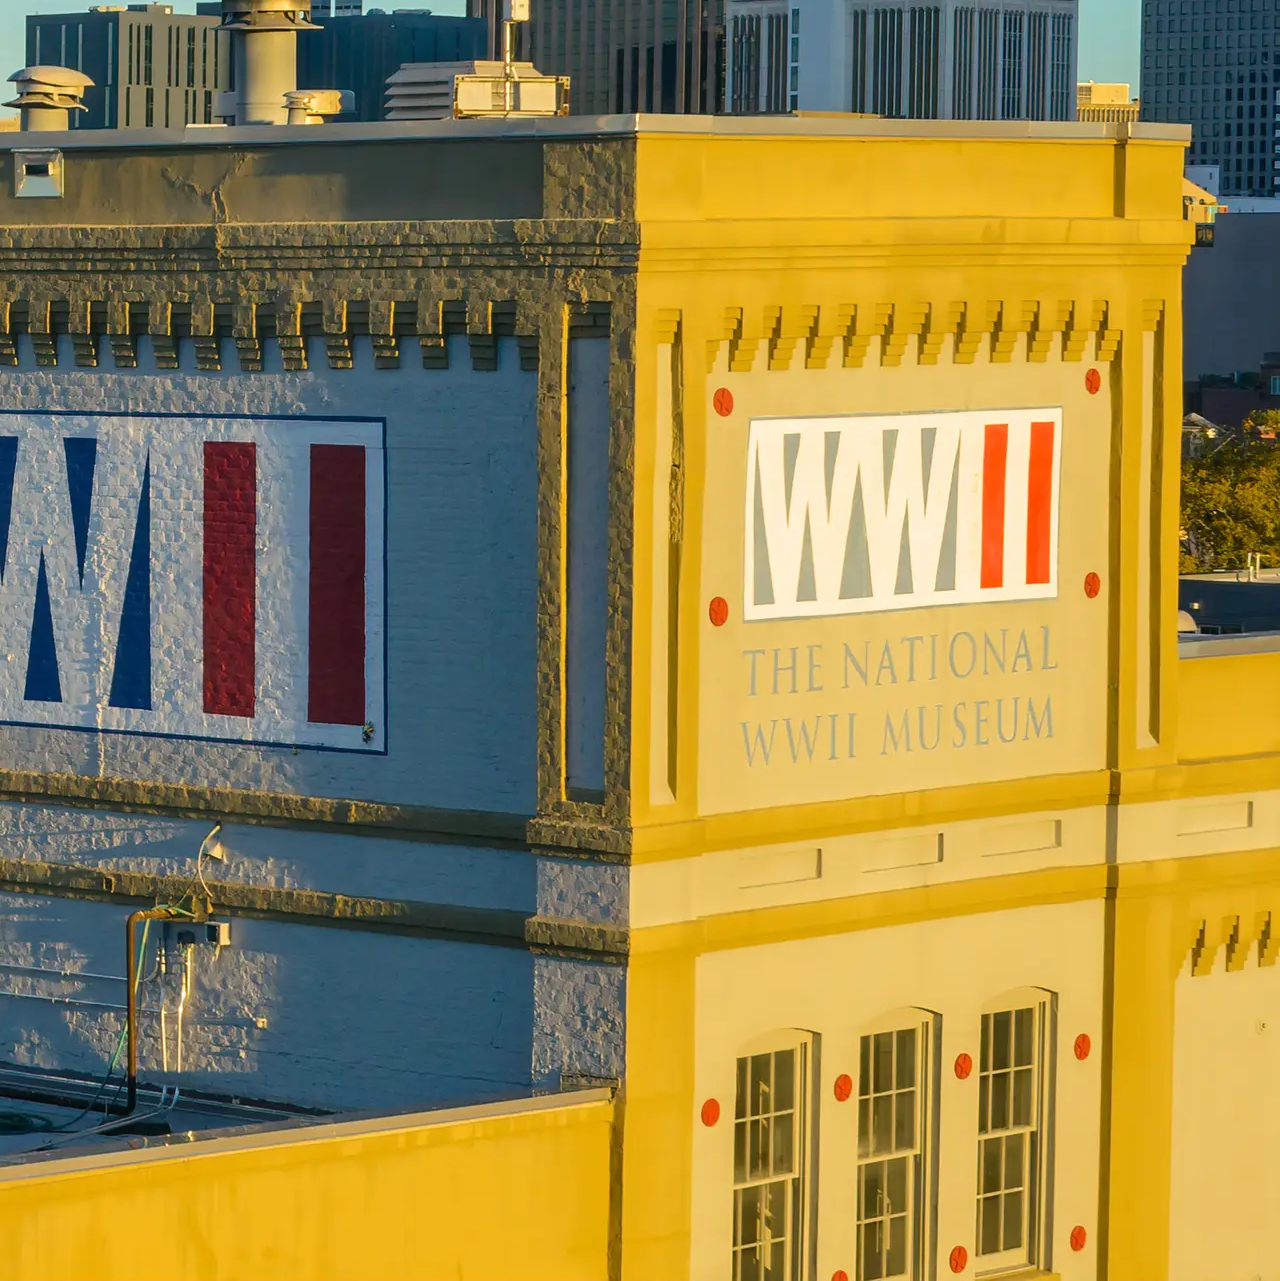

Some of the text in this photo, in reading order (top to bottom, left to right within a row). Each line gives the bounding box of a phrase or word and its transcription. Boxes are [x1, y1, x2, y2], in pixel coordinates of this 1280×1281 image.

[752, 420, 1056, 607] WWII
[742, 625, 1059, 697] THE NATIONAL
[740, 695, 1055, 768] WWII MUSEUM
